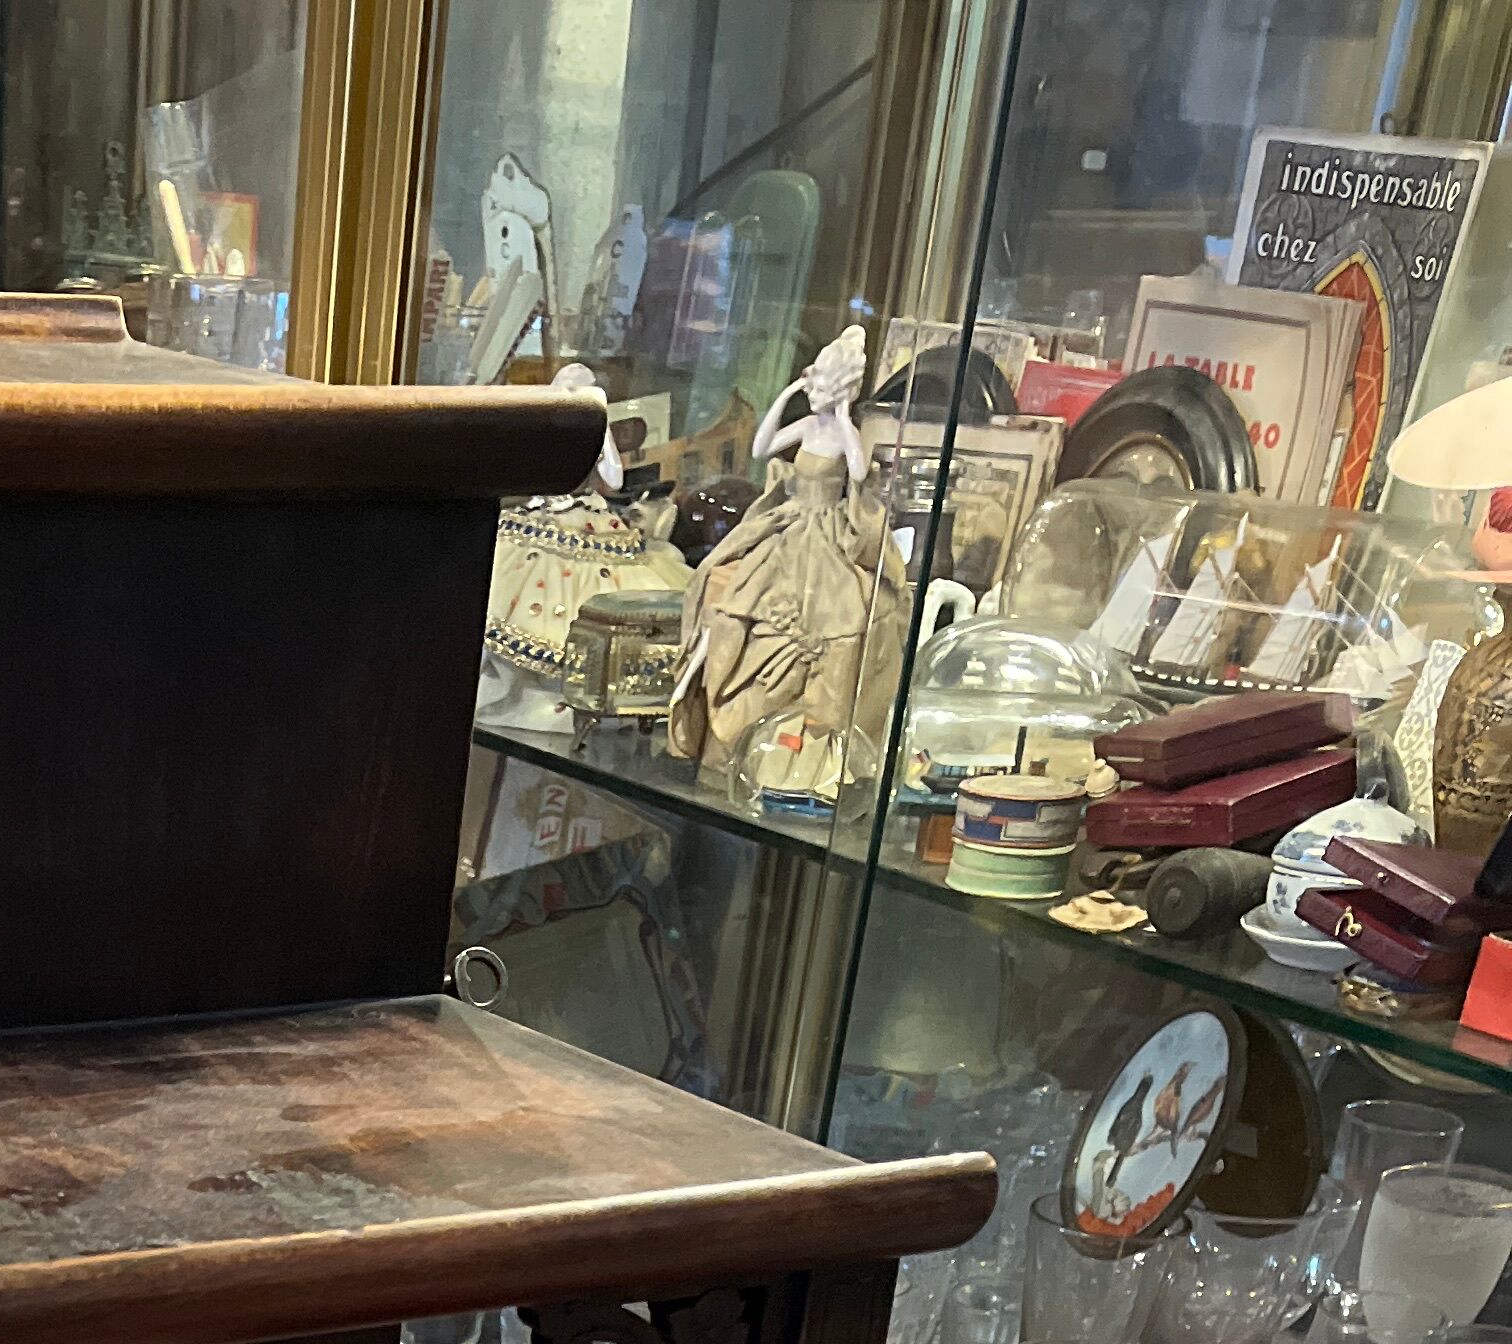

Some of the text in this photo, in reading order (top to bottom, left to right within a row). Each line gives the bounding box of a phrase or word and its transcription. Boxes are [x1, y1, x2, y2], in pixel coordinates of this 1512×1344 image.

[1280, 152, 1463, 213] indispensable
[1256, 223, 1448, 282] chez soi
